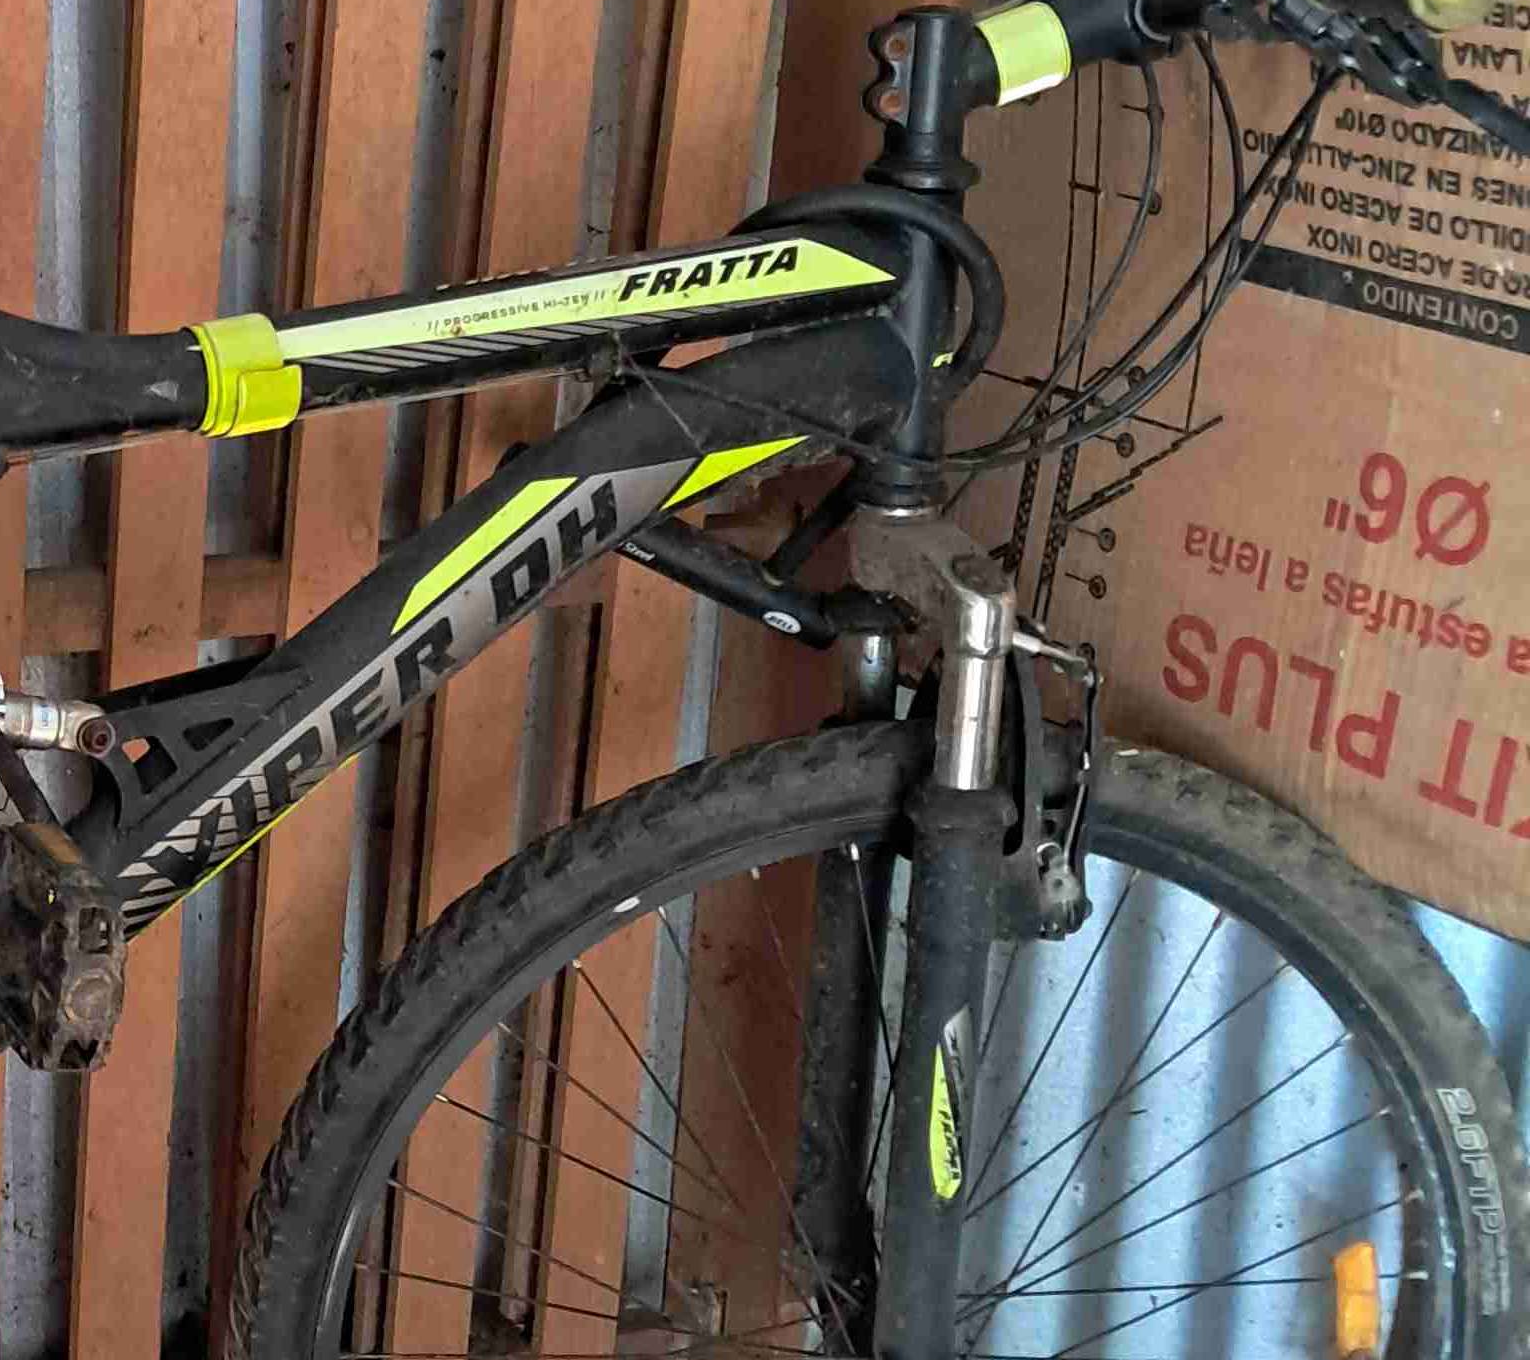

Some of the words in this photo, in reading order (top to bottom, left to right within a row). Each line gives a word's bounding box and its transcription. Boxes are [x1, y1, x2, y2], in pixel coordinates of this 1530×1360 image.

[1456, 41, 1523, 76] LANA
[1427, 168, 1460, 196] EN
[1321, 187, 1402, 226] ACERO
[1408, 206, 1443, 235] DE
[1307, 224, 1362, 260] INOX
[1368, 240, 1454, 281] ACERO
[617, 245, 799, 302] FRATTA
[1461, 261, 1496, 290] DE
[1363, 281, 1520, 339] CONTENIDO
[488, 479, 619, 623] DH
[1183, 524, 1271, 590] leña
[1285, 557, 1310, 592] a
[1322, 572, 1492, 658] estufas
[1161, 613, 1401, 779] PLUS
